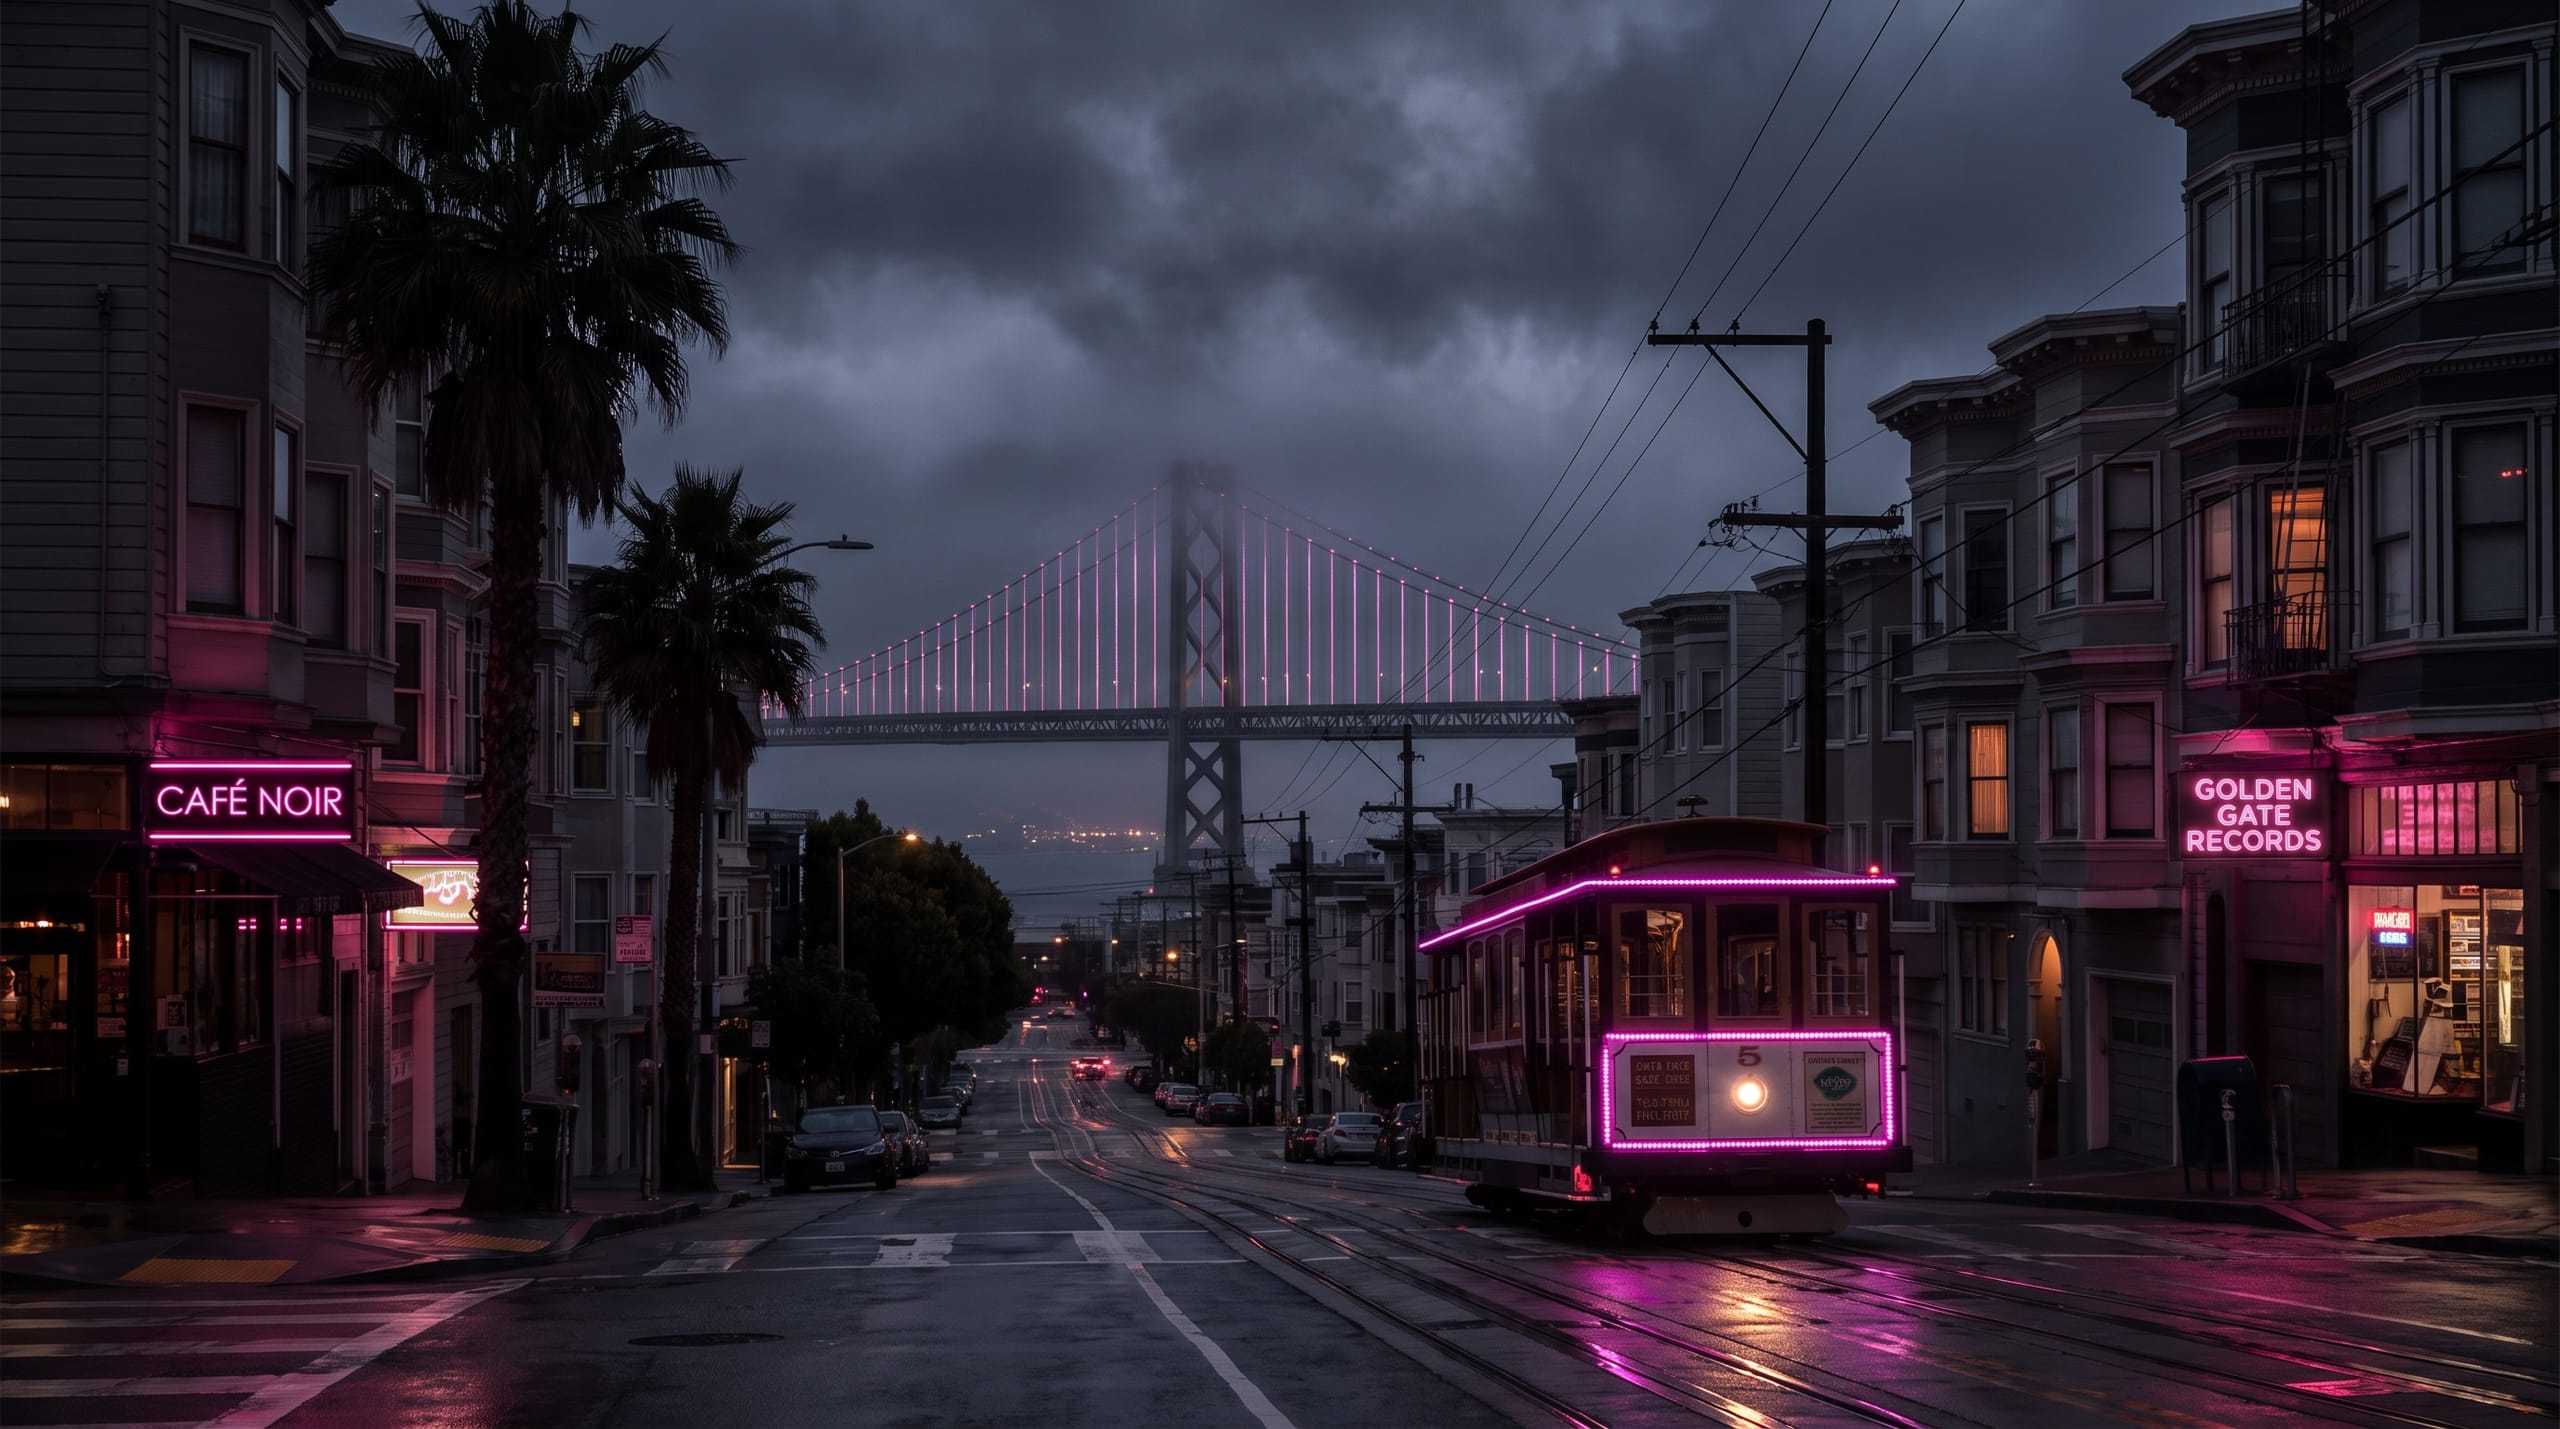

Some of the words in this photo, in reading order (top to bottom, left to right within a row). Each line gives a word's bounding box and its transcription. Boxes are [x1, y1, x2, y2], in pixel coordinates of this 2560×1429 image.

[157, 778, 248, 816] CAFÉ
[259, 786, 342, 816] NOIR
[2194, 778, 2312, 801] GOLDEN
[2217, 804, 2291, 826] GATE
[2186, 829, 2322, 852] RECORDS
[1738, 1045, 1762, 1067] 5
